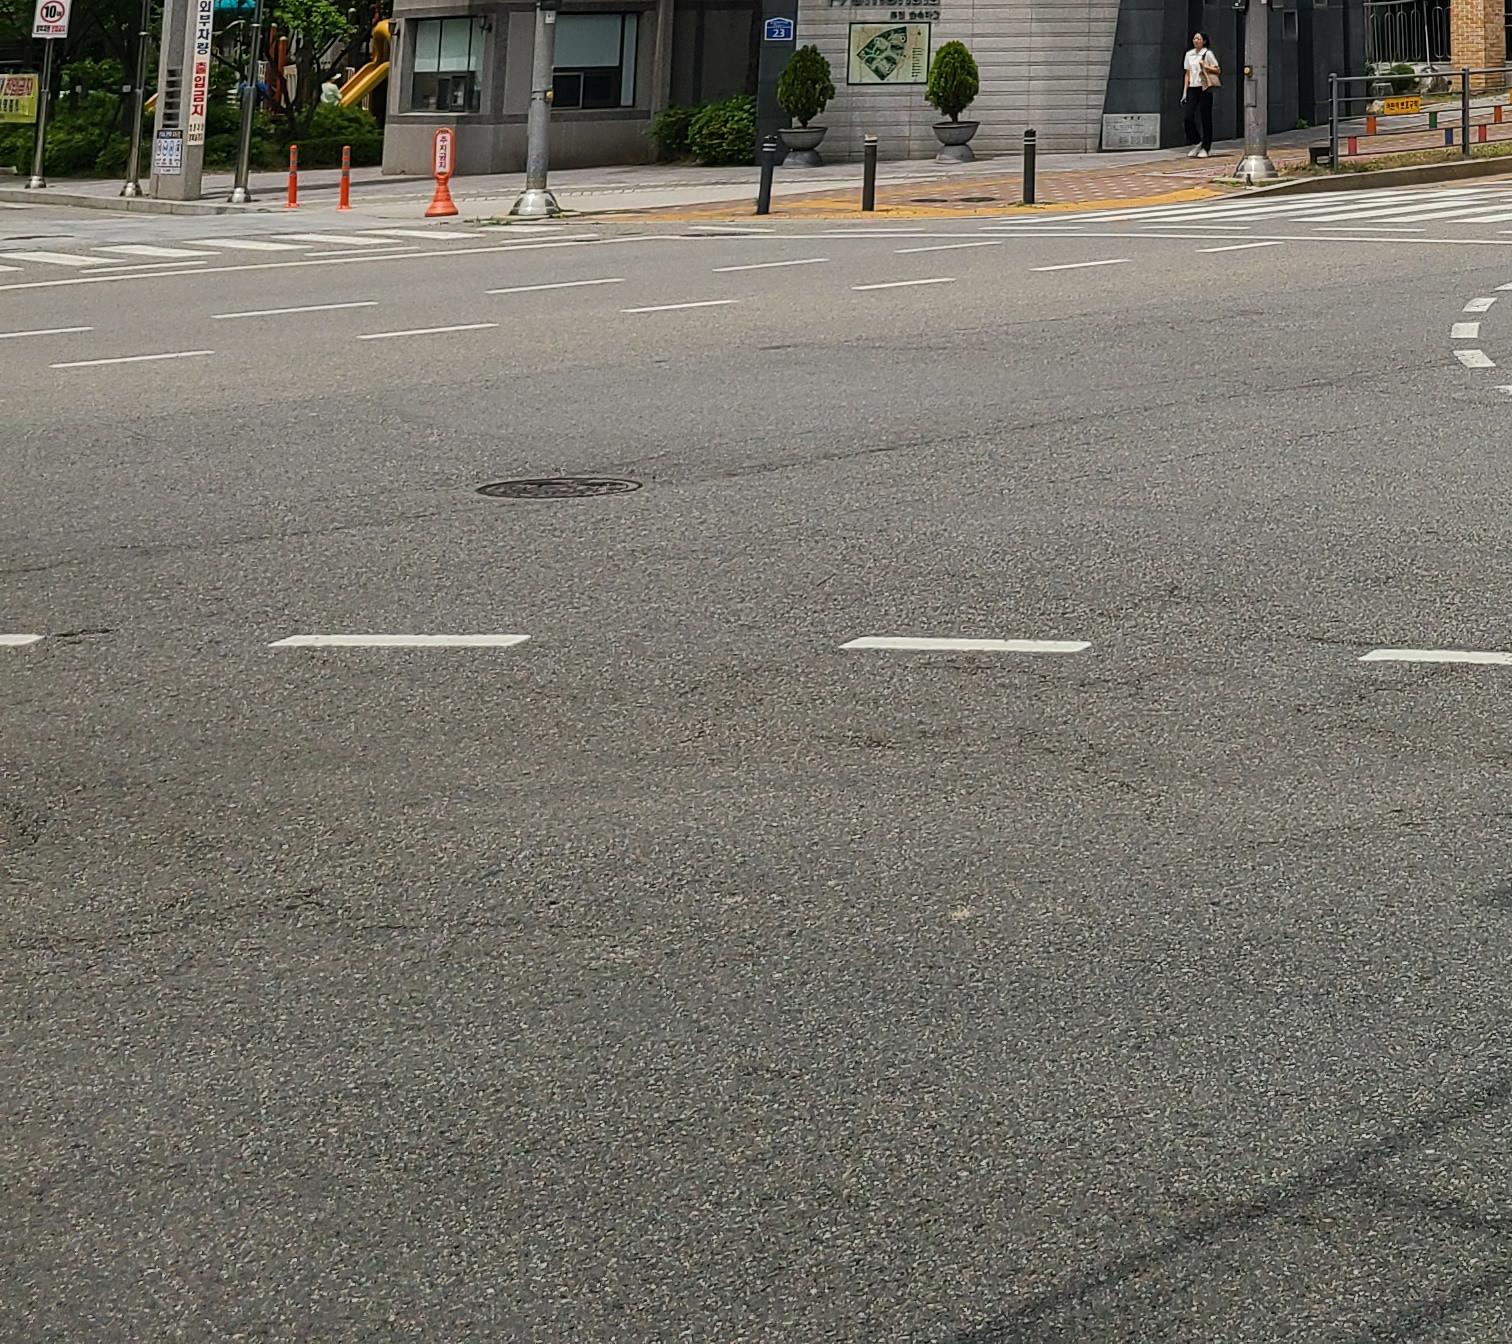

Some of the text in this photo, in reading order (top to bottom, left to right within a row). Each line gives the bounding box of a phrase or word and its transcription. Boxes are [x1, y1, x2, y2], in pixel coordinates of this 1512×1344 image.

[197, 0, 212, 55] 외부차량
[772, 29, 785, 38] 23
[191, 62, 207, 117] 출입금지
